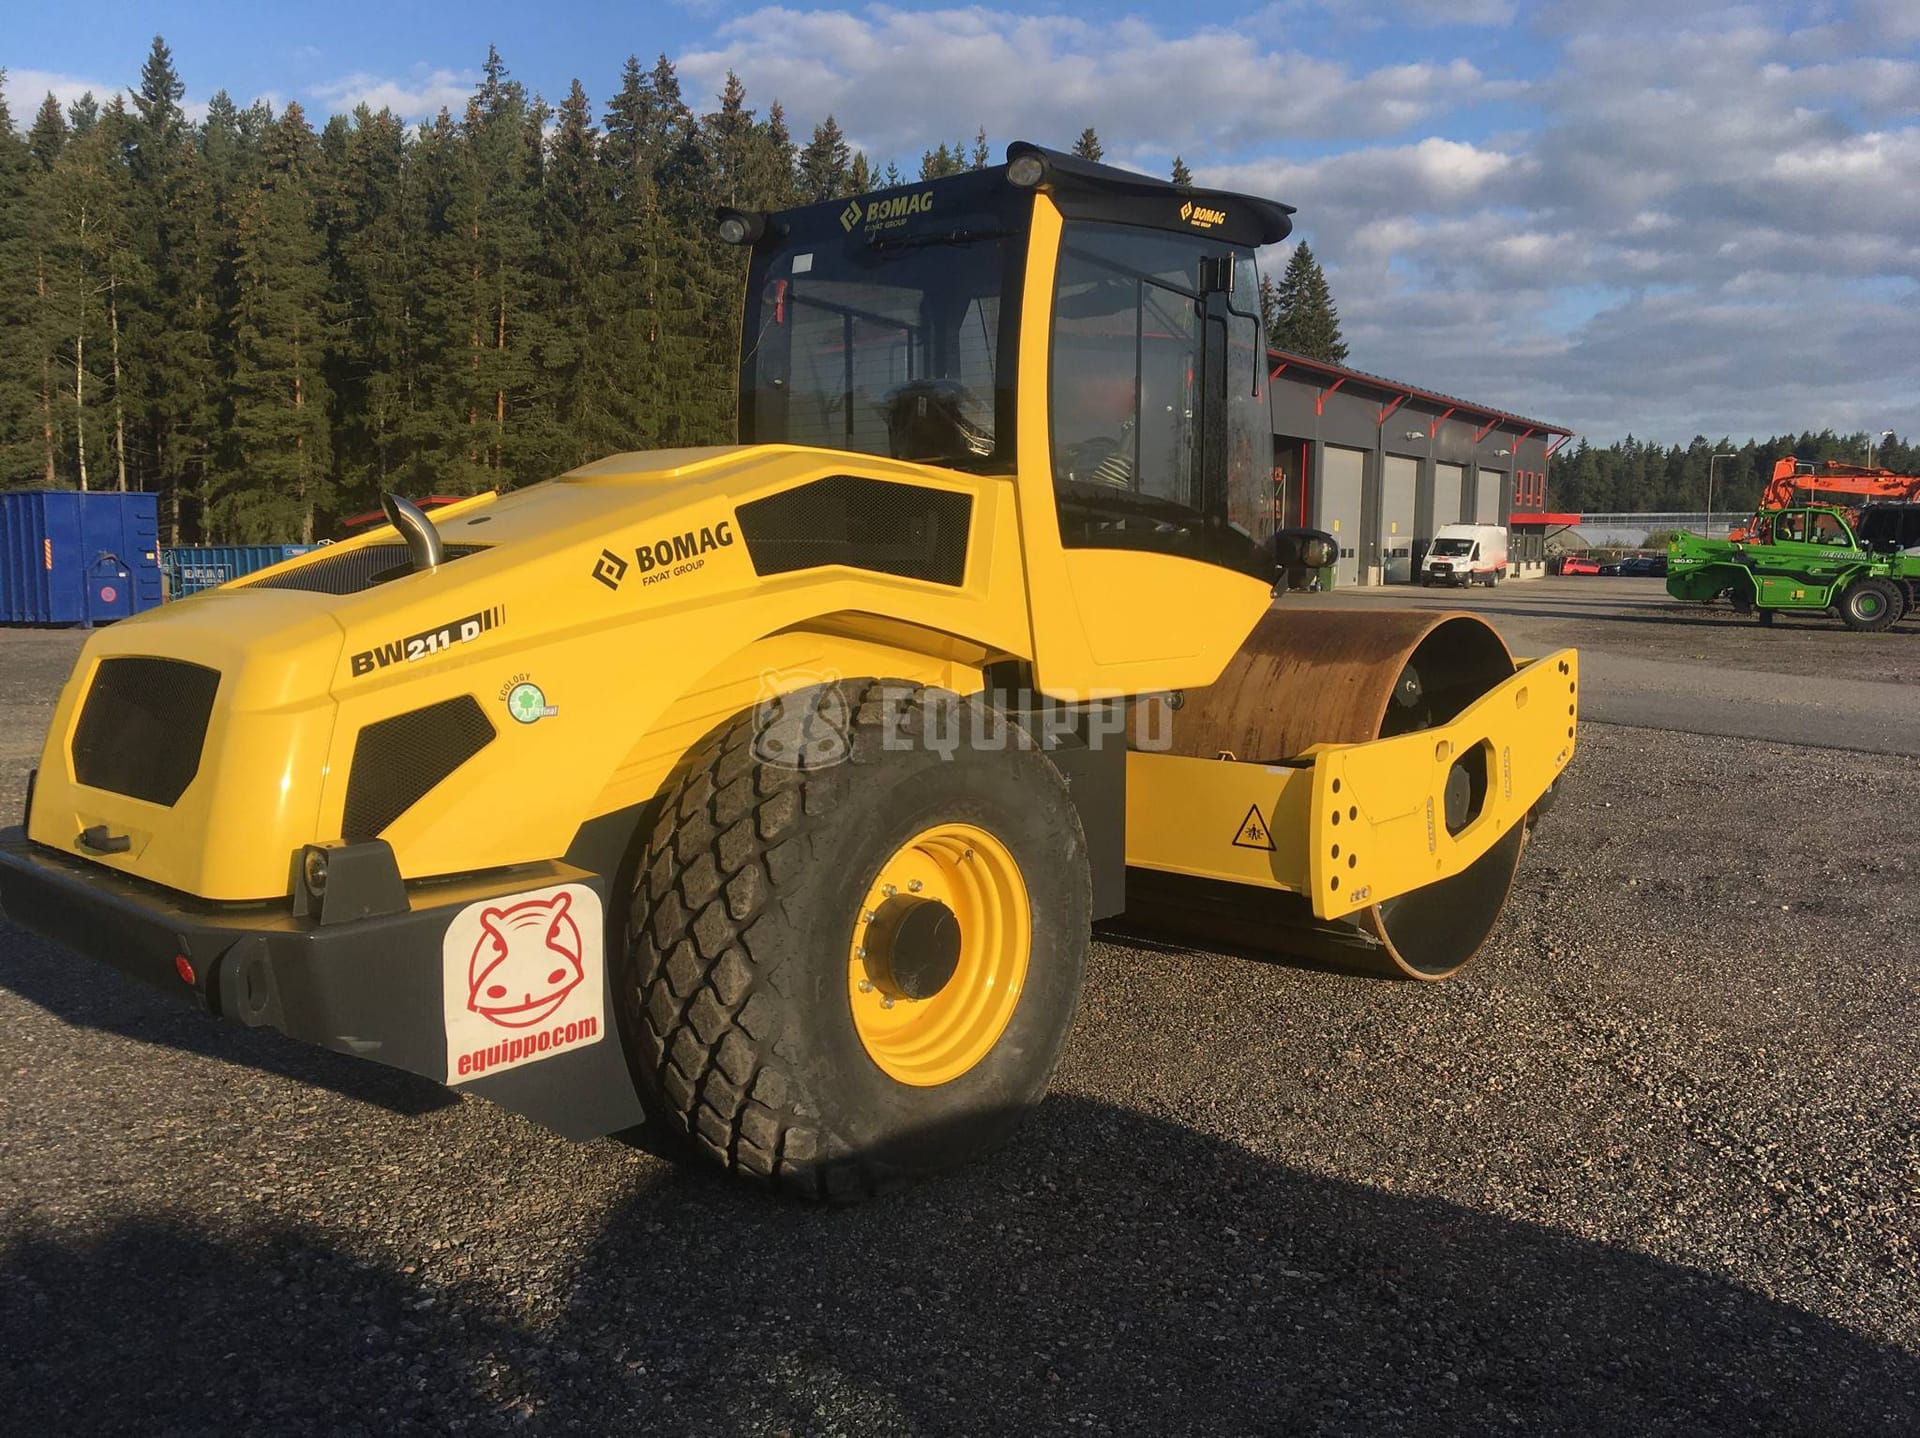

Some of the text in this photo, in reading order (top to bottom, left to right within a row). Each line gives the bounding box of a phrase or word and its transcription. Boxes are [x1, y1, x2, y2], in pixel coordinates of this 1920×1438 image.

[866, 191, 934, 222] BOMAG
[1192, 206, 1226, 225] BOMAG
[635, 521, 733, 573] BOMAG
[642, 559, 705, 587] FAYAT GROUP
[461, 620, 480, 643] D
[498, 672, 531, 702] ECOLOGY
[457, 1016, 598, 1076] equippo.com
